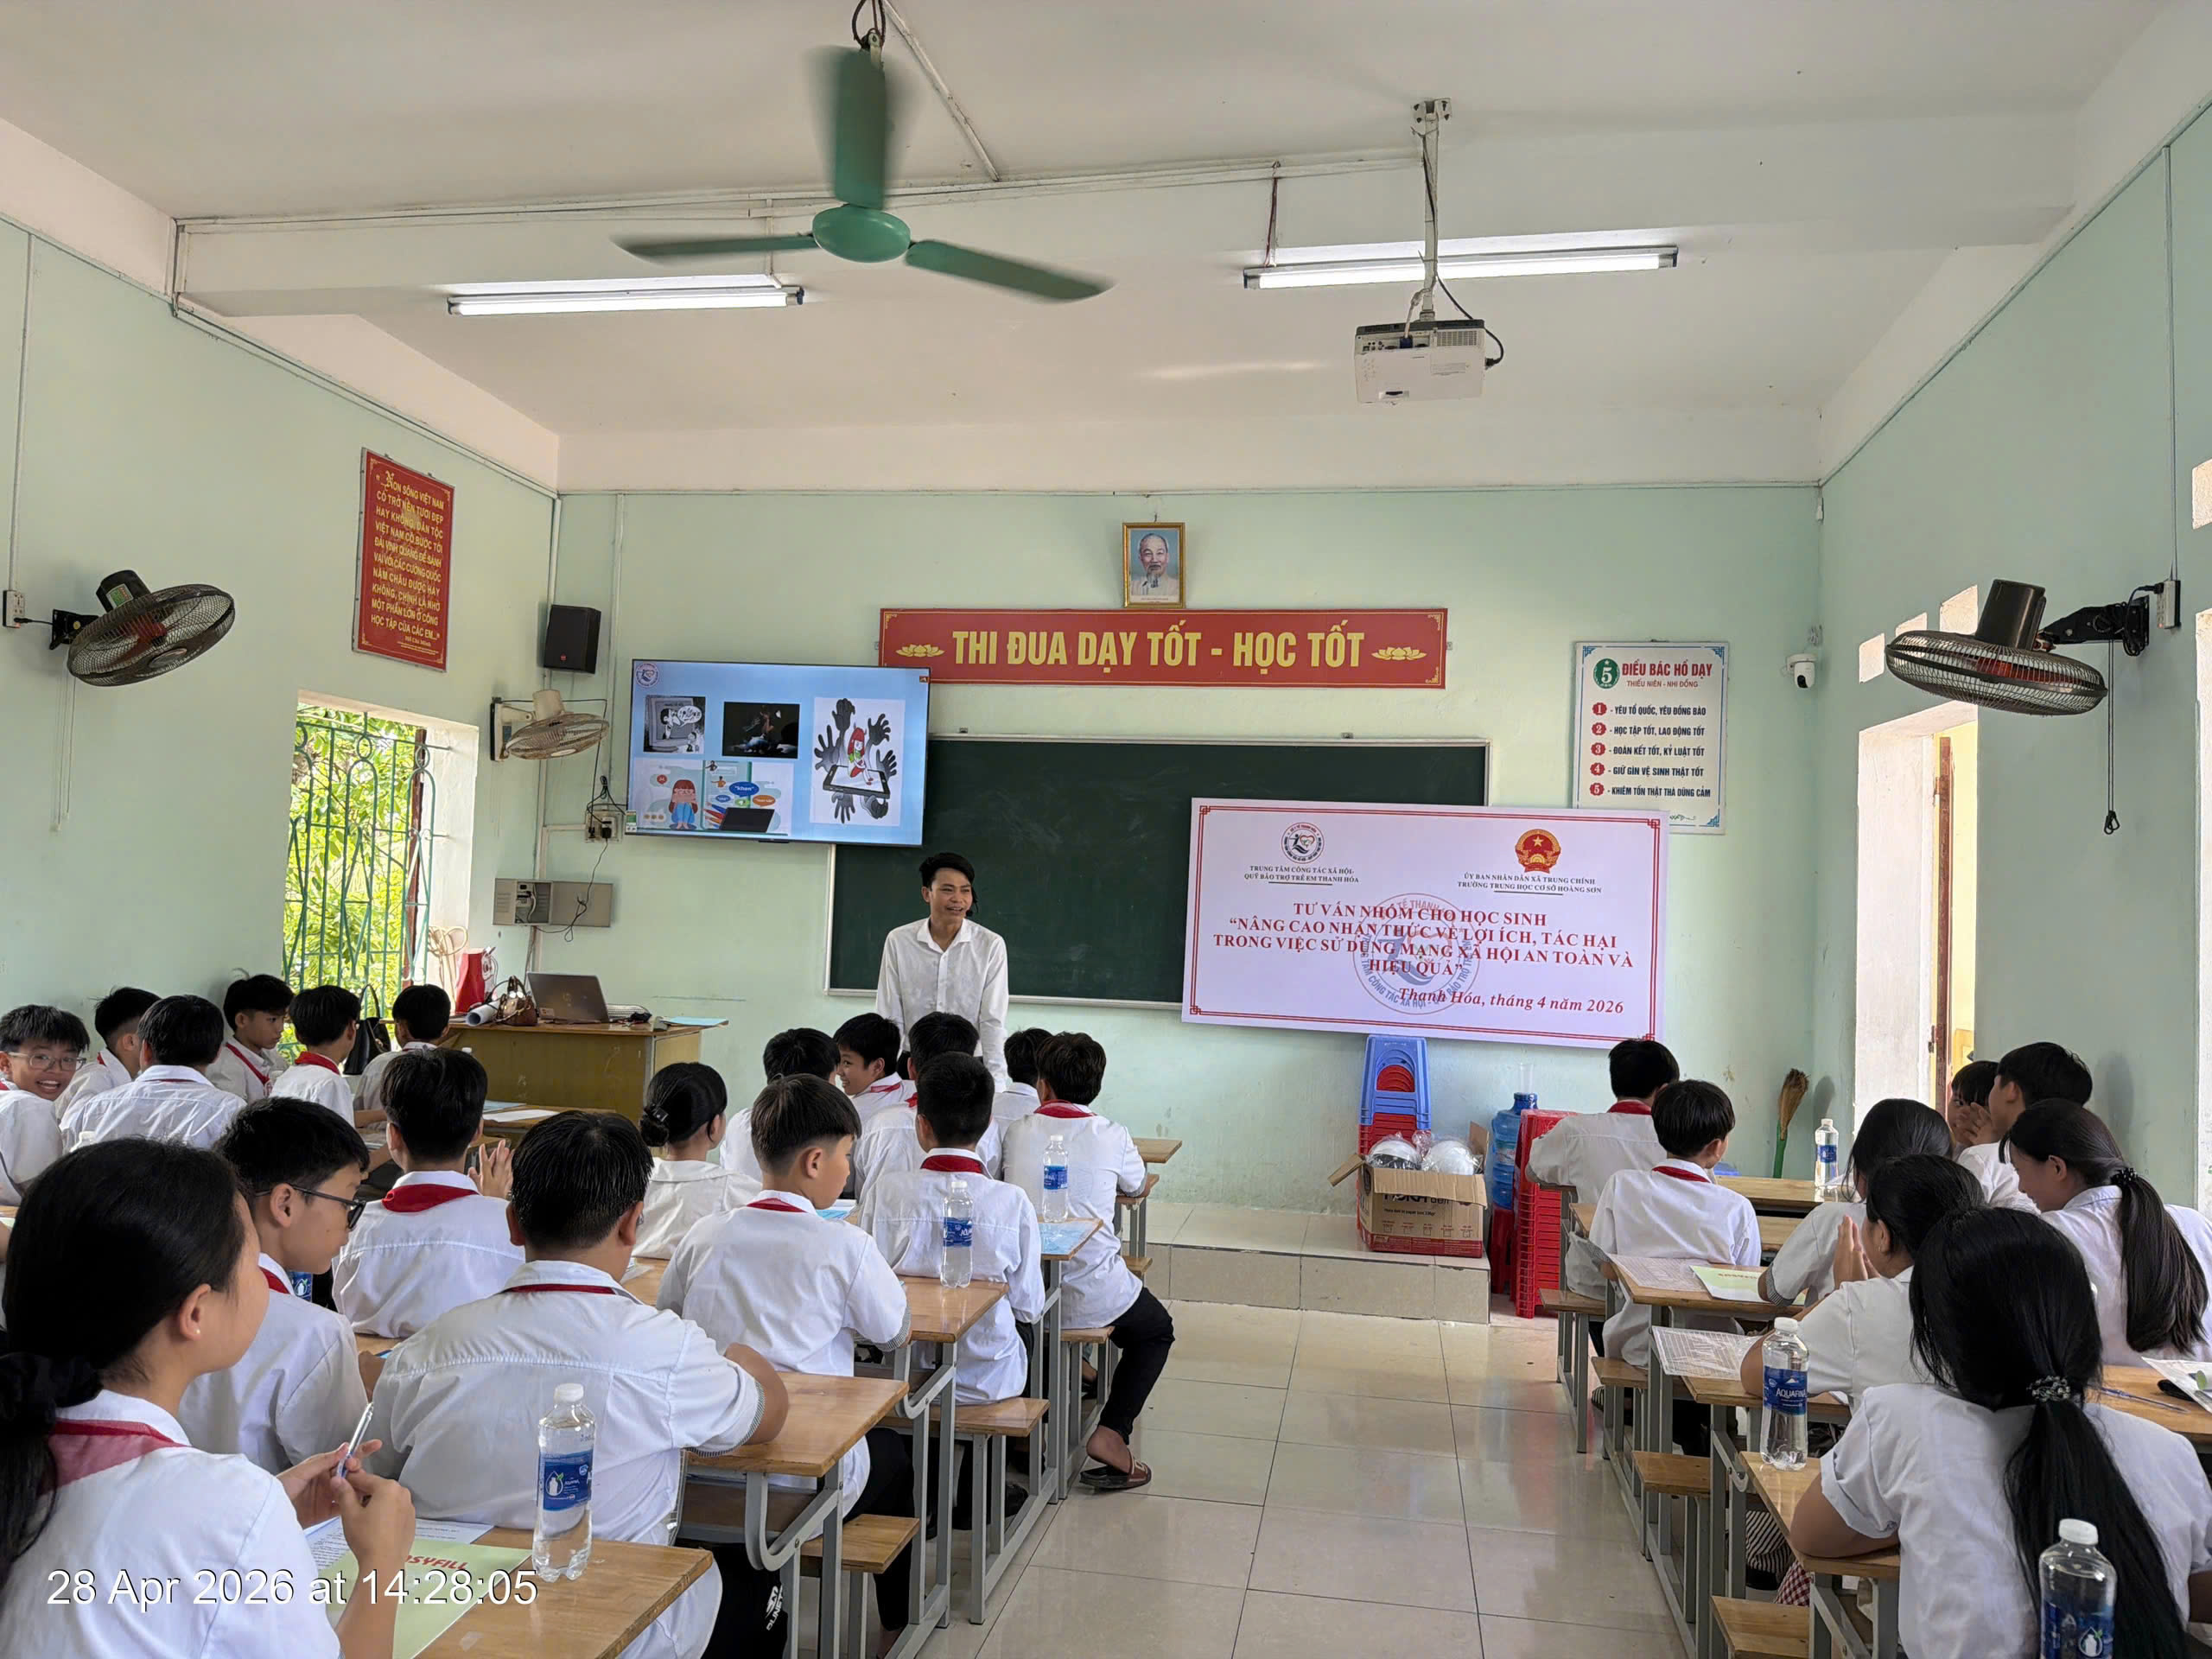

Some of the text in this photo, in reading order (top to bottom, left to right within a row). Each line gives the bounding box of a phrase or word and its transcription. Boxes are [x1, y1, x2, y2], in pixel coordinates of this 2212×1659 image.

[952, 631, 997, 664] THI
[1007, 632, 1068, 665] ĐUA
[1077, 632, 1137, 674] DẠY
[1147, 620, 1201, 667] TỐT
[1233, 632, 1296, 675] HỌC
[1307, 620, 1365, 667] TỐT
[1602, 659, 1713, 683] 5 ĐIỀU BÁC HỒ DẠY
[1680, 679, 1698, 688] ĐỒNG
[1615, 705, 1627, 715] YÊU
[1629, 703, 1637, 715] TỔ
[1659, 705, 1672, 715] YÊU
[1673, 704, 1691, 715] ĐỒNG
[1693, 705, 1706, 715] BÀO
[1614, 727, 1627, 736] HỌC
[1630, 725, 1642, 736] TẬP
[1659, 727, 1671, 735] LAO
[1673, 727, 1691, 737] ĐỘNG
[1693, 724, 1705, 735] TỐT
[1613, 746, 1631, 754] ĐOÀN
[1633, 744, 1646, 755] KẾT
[1675, 747, 1691, 757] LUẬT
[1693, 746, 1705, 756] TỐT
[1613, 766, 1626, 775] GIỮ
[1627, 766, 1639, 775] GÌN
[1642, 766, 1650, 777] VỆ
[1652, 767, 1669, 776] SINH
[1672, 767, 1688, 778] THẬT
[1692, 766, 1704, 776] TỐT
[1611, 786, 1631, 795] KHIÊM
[1633, 785, 1645, 795] TỐN
[1647, 787, 1662, 798] THẬT
[1664, 787, 1676, 796] THÀ
[1677, 787, 1694, 797] DŨNG
[1696, 785, 1710, 797] CẢM
[1244, 872, 1259, 881] QUỸ
[1344, 874, 1359, 883] HÓA
[1547, 883, 1556, 892] SỞ
[1558, 884, 1585, 893] HOÀNG
[1294, 900, 1547, 926] TƯ VẤN NHÓM CHO HỌC SINH
[1230, 916, 1617, 950] “NÂNG CAO NHẬN THỨC VỀ LỢI ÍCH, TÁC HẠI
[1213, 934, 1633, 968] TRONG VIỆC SỬ DỤNG MẠNG XÃ HỘI AN TOÀN VÀ
[1370, 958, 1462, 976] HIỆU QUẢ”
[1400, 988, 1624, 1014] Thanh Hóa, tháng 4 năm 2026
